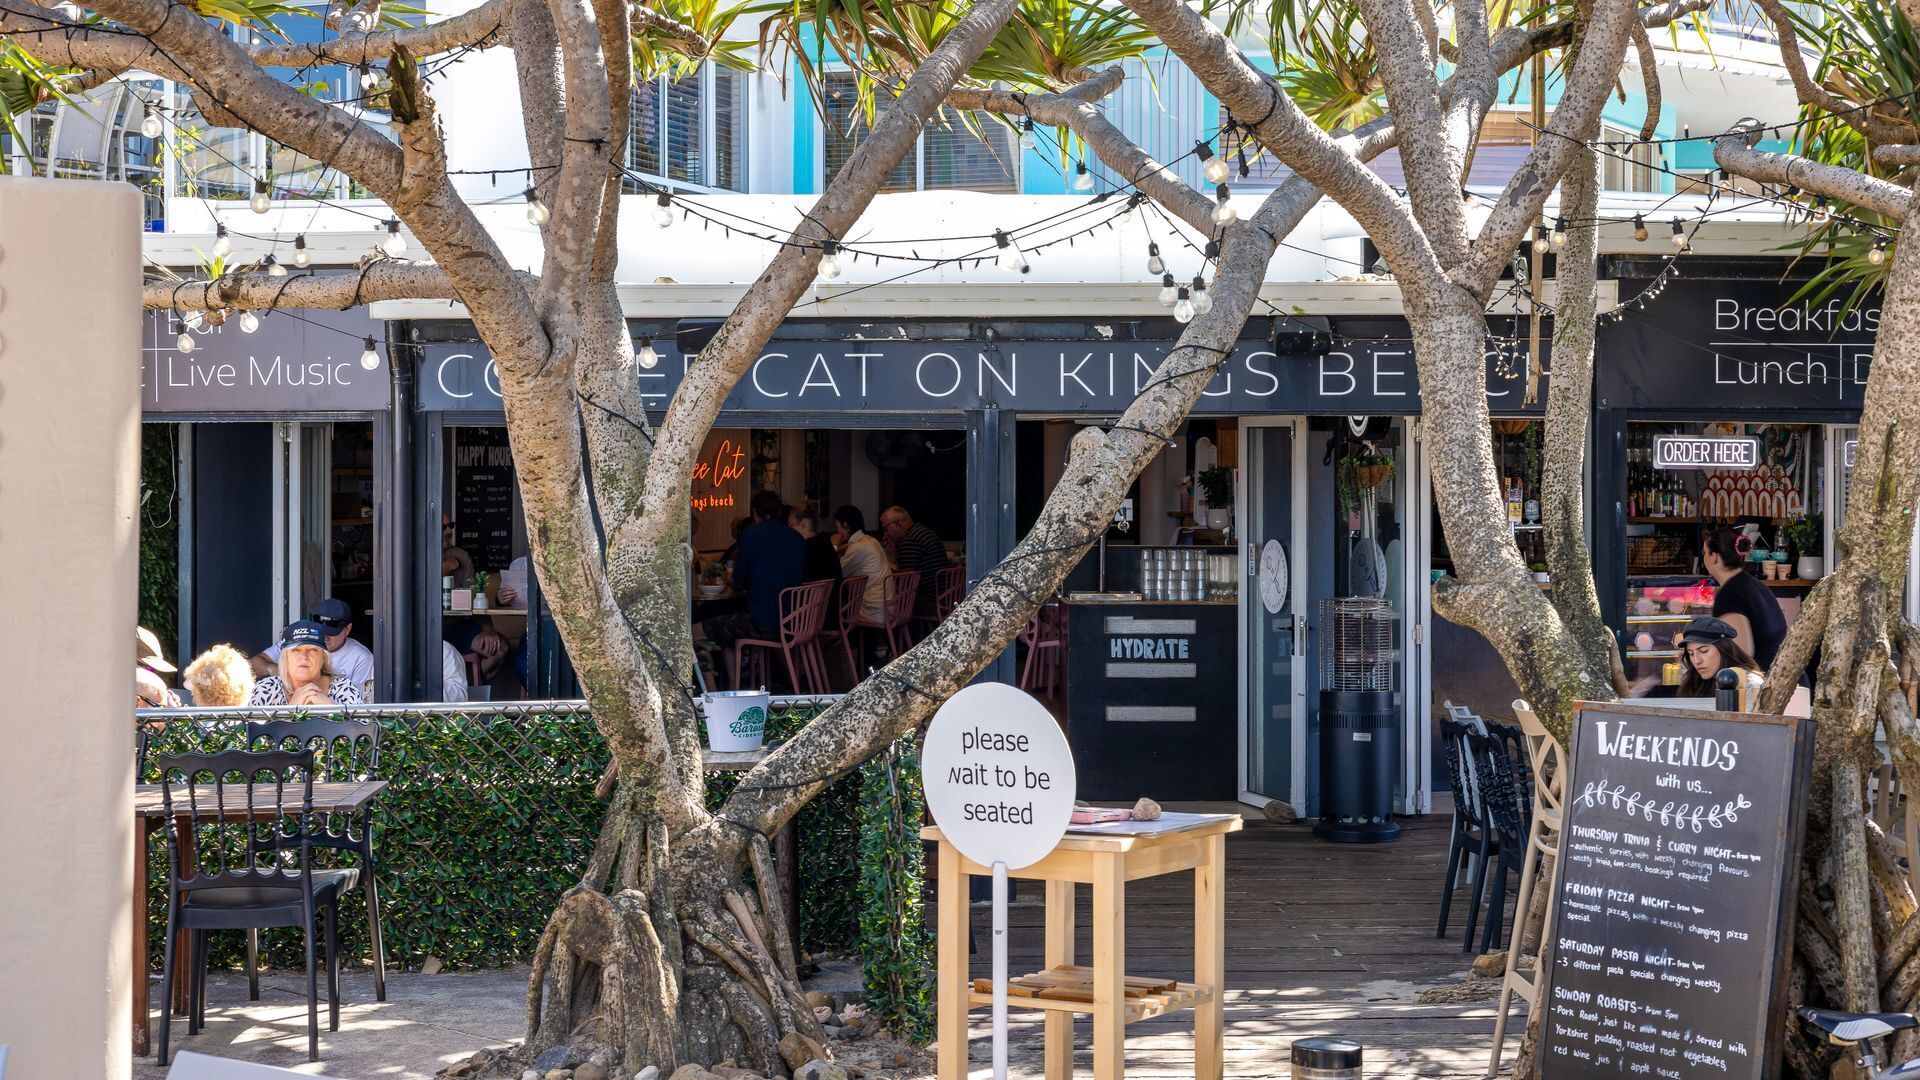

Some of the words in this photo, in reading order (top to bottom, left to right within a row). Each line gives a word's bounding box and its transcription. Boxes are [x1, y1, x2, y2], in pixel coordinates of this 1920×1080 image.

[1714, 298, 1881, 332] Breakfas
[168, 356, 236, 387] Live
[249, 354, 352, 386] Music
[752, 352, 884, 398] CAT
[916, 352, 1017, 398] ON
[1715, 352, 1827, 385] Lunch
[457, 446, 485, 467] HAPPY
[488, 446, 513, 467] HOUR
[714, 439, 745, 487] Cat
[1663, 441, 1711, 463] ORDER
[1714, 442, 1750, 463] HERE
[690, 496, 708, 512] ings
[710, 493, 734, 507] beach
[1110, 638, 1189, 660] HYDRATE
[962, 727, 1029, 754] please
[1596, 721, 1739, 771] WEEKENDS
[995, 765, 1016, 788] to
[1024, 765, 1050, 790] be
[1656, 773, 1681, 789] with
[1687, 780, 1713, 794] us...
[964, 801, 1033, 825] seated
[1572, 825, 1618, 843] THURSDAY
[1624, 833, 1650, 847] TRIVIA
[1668, 841, 1697, 855] CURRY
[1635, 851, 1649, 860] with
[1654, 854, 1675, 868] weekly
[1682, 858, 1713, 875] changing
[1644, 865, 1674, 879] bookings
[1565, 882, 1603, 898] FRIDAY
[1608, 888, 1635, 903] PIZZA
[1632, 913, 1648, 921] with
[1660, 919, 1683, 933] weekly
[1688, 925, 1720, 943] changing
[1726, 930, 1749, 942] pizza
[1559, 938, 1604, 956] SATURDAY
[1611, 947, 1639, 962] PASTA
[1573, 960, 1602, 971] different
[1607, 965, 1624, 976] pasta
[1630, 968, 1655, 980] specials
[1660, 972, 1690, 988] changing
[1554, 987, 1591, 1004] SUNDAY
[1645, 1005, 1661, 1015] from
[1665, 1008, 1679, 1020] 5pm
[1555, 1024, 1588, 1040] Yorkshire
[1626, 1041, 1655, 1053] roasted
[1660, 1048, 1677, 1057] root
[1602, 1015, 1618, 1027] just
[1623, 1020, 1636, 1032] like
[1661, 1029, 1681, 1040] made
[1696, 1033, 1723, 1049] served
[1728, 1042, 1748, 1057] with
[1553, 1045, 1568, 1055] red
[1573, 1049, 1590, 1060] wine
[1596, 1055, 1610, 1066] jus
[1630, 1062, 1650, 1075] apple
